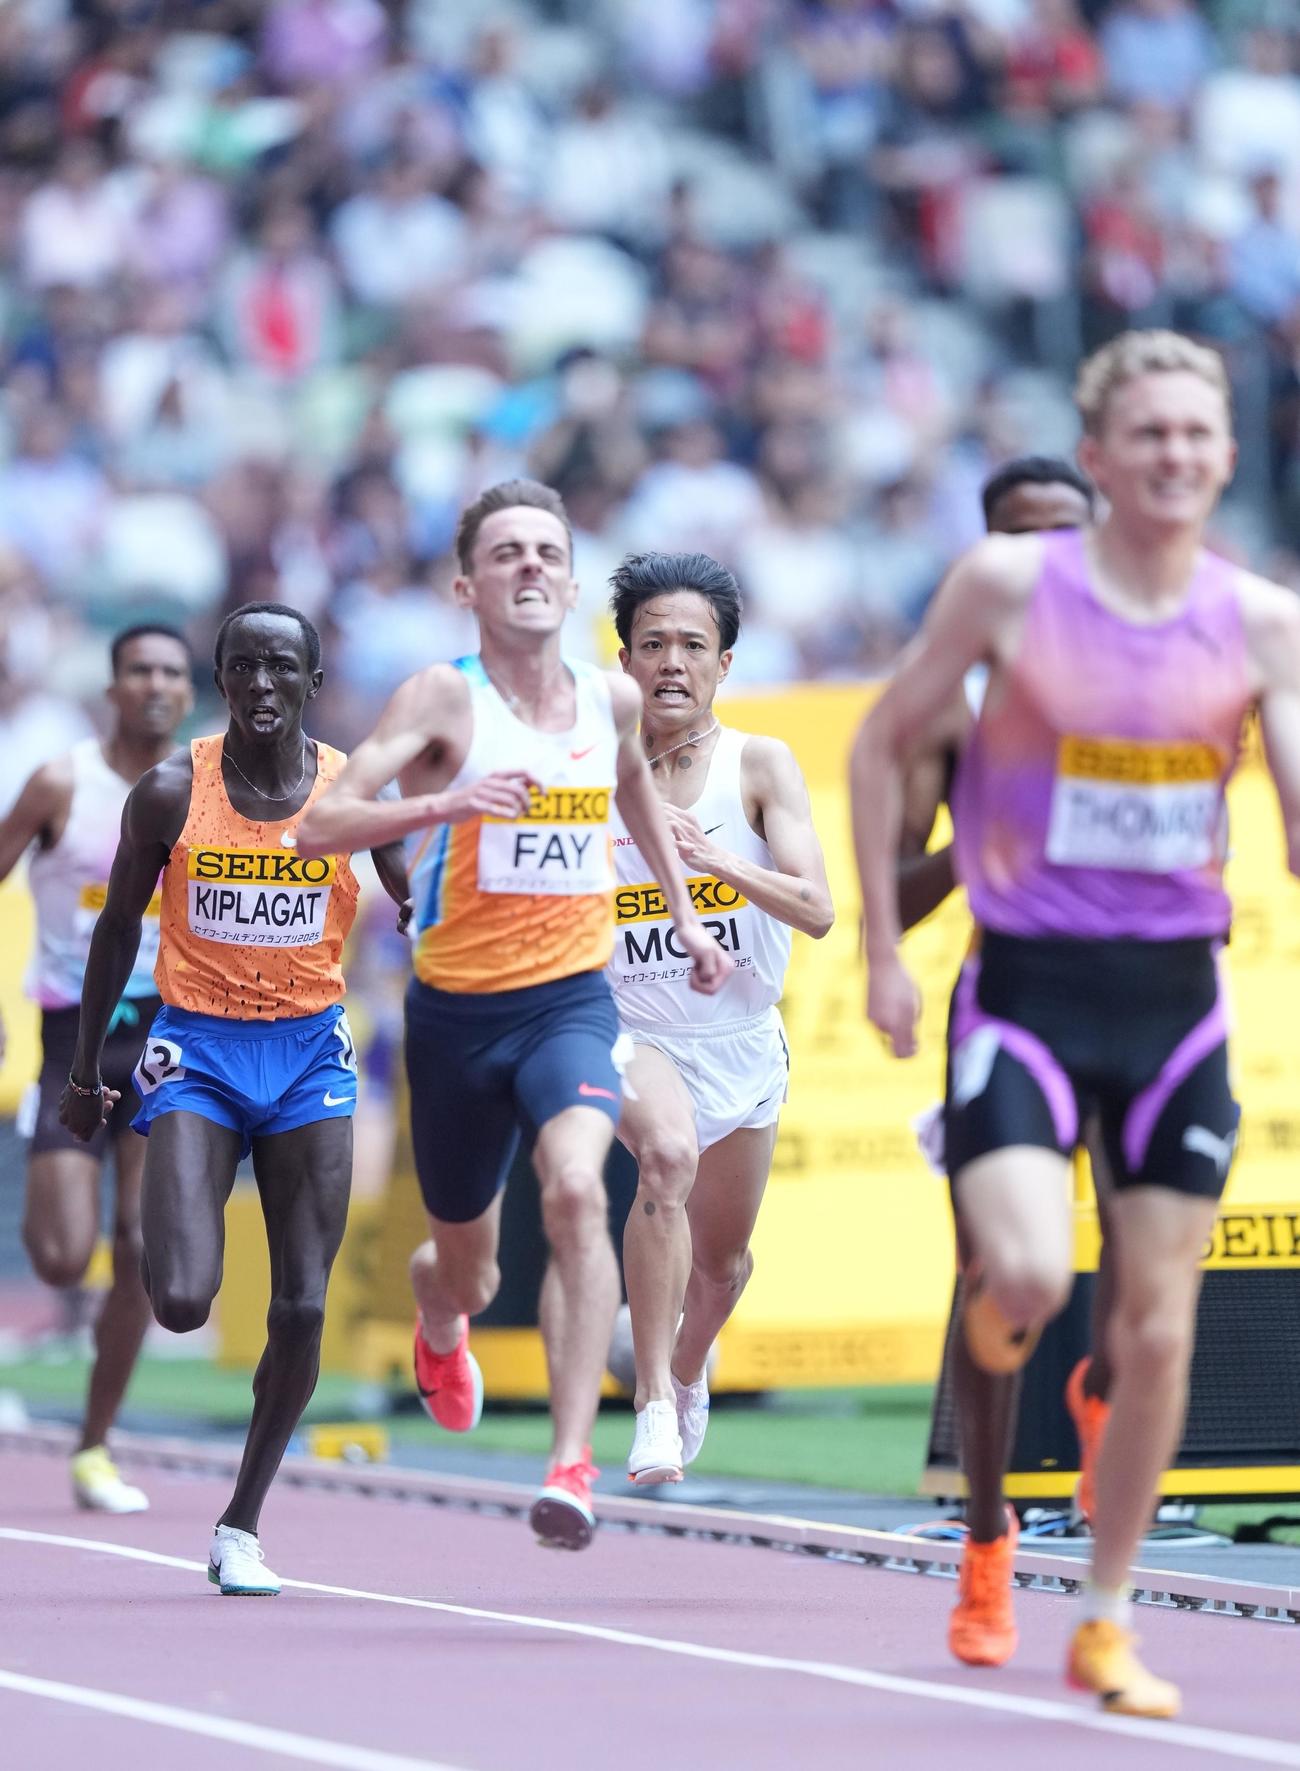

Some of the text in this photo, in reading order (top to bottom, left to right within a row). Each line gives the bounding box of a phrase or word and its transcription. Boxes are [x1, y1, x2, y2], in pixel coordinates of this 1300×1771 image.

[524, 792, 608, 820] EIKO
[196, 851, 330, 883] SEIKO
[514, 833, 592, 869] FAY
[195, 886, 322, 927] KIPLAGAT
[615, 881, 740, 919] SEKO
